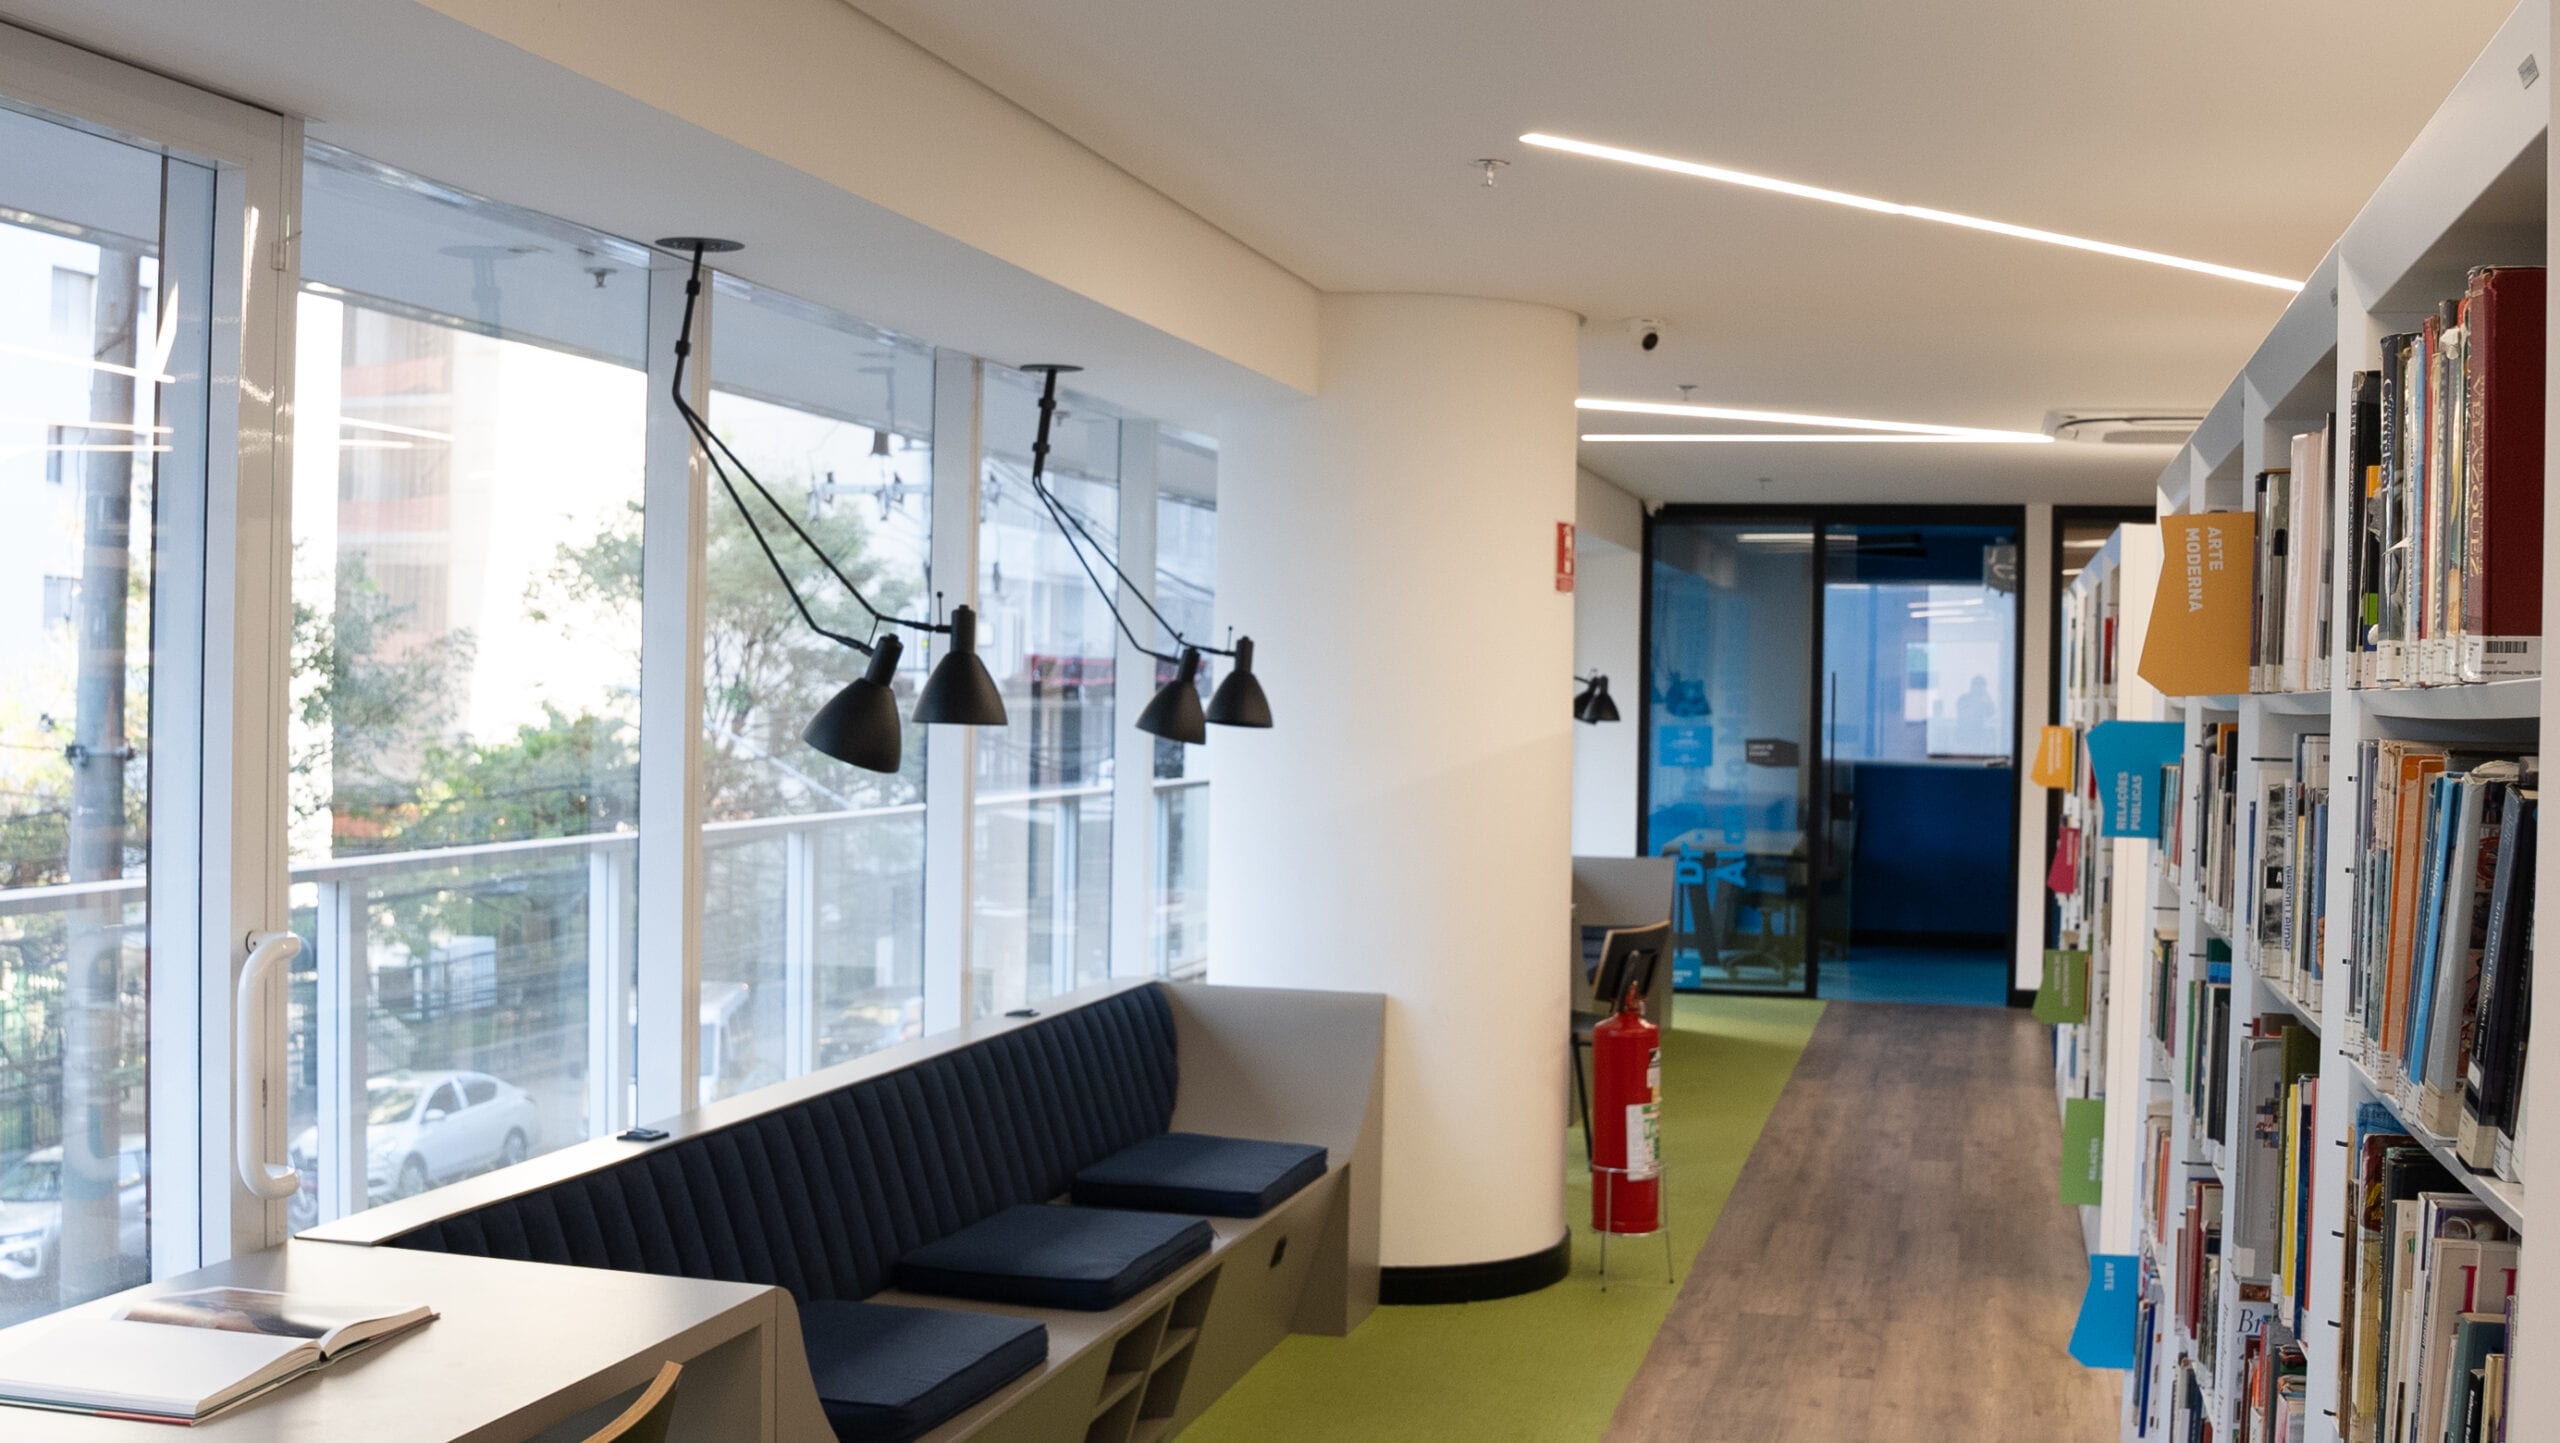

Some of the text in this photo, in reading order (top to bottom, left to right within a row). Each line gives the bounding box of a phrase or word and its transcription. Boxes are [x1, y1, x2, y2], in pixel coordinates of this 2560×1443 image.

[2470, 375, 2482, 578] VELAZQUEZ
[2185, 527, 2203, 613] MODERNA
[2208, 526, 2224, 571] ARTE
[2115, 771, 2129, 831] RELAÇÕES
[2104, 1262, 2115, 1291] ARTE
[2237, 1308, 2261, 1334] Br
